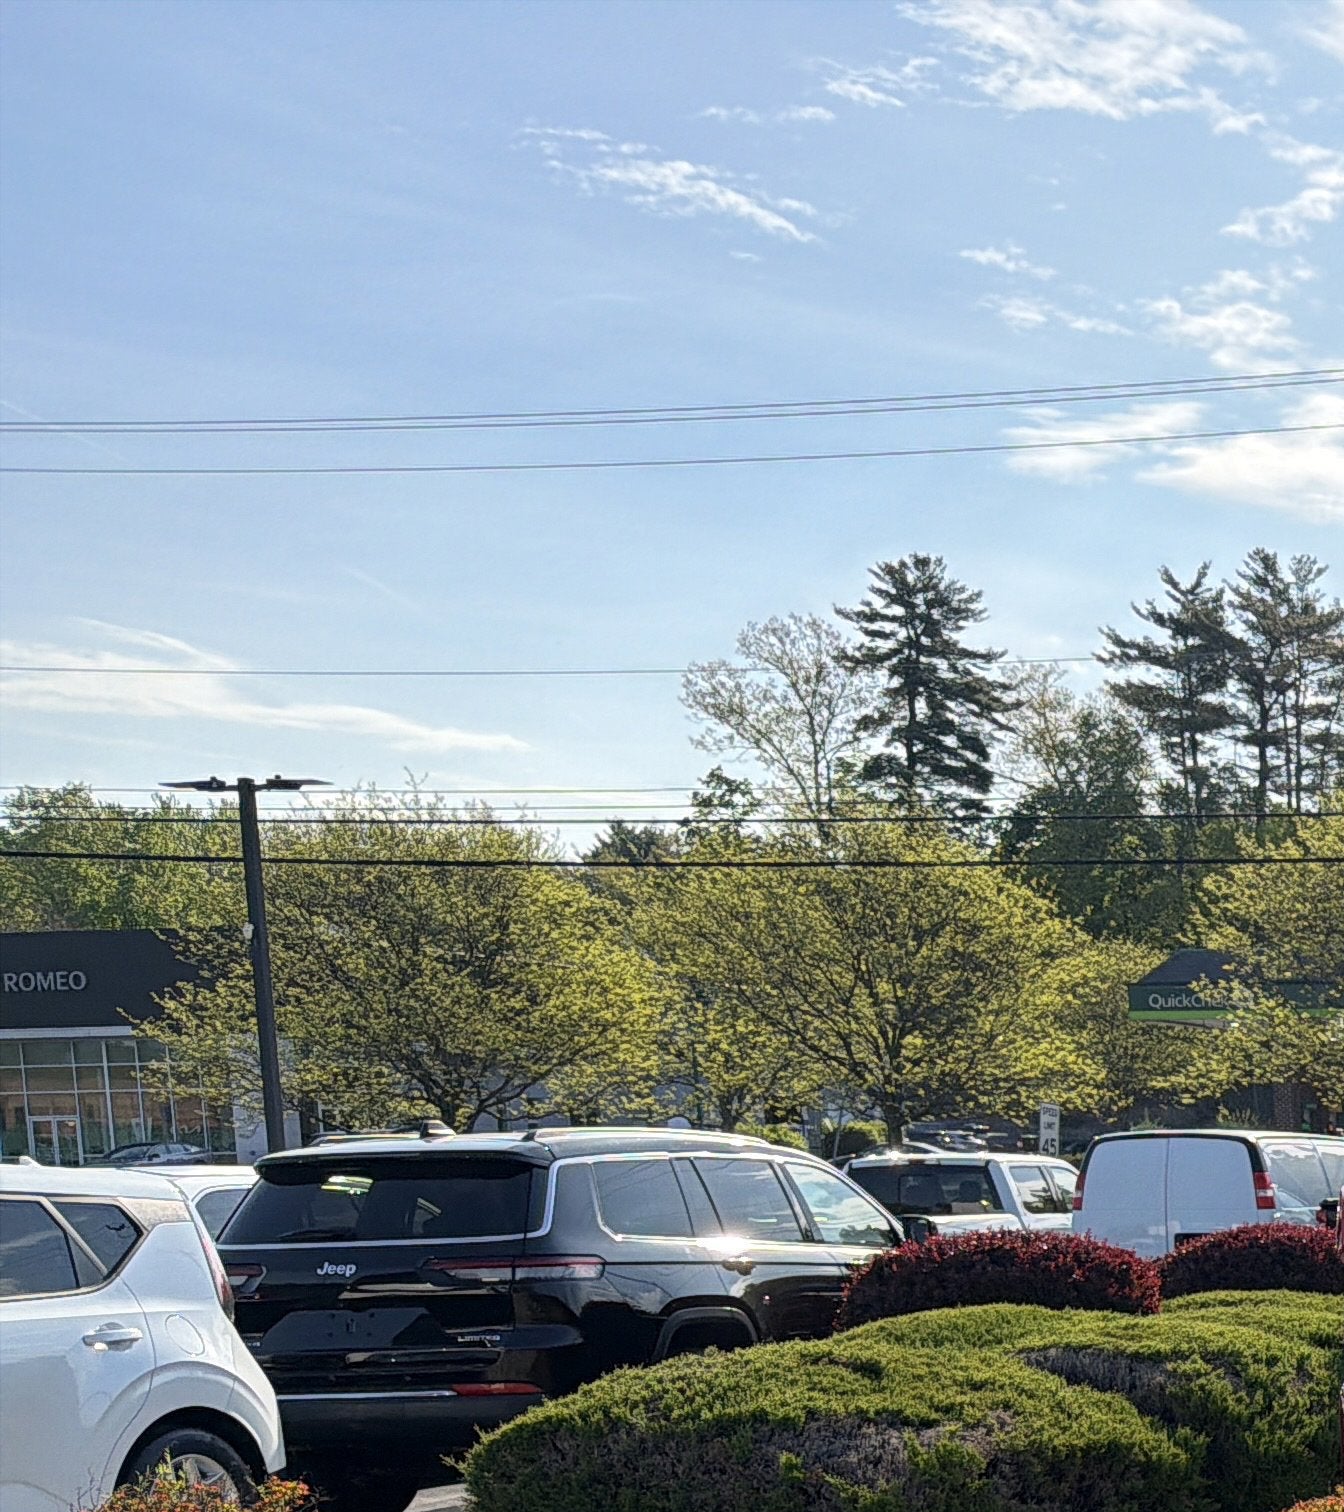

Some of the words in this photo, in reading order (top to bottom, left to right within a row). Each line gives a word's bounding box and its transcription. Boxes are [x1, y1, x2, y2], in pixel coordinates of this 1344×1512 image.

[3, 971, 87, 992] ROMEO
[1042, 1106, 1058, 1117] SPEED
[1042, 1138, 1057, 1155] 45
[316, 1261, 357, 1278] Jeep
